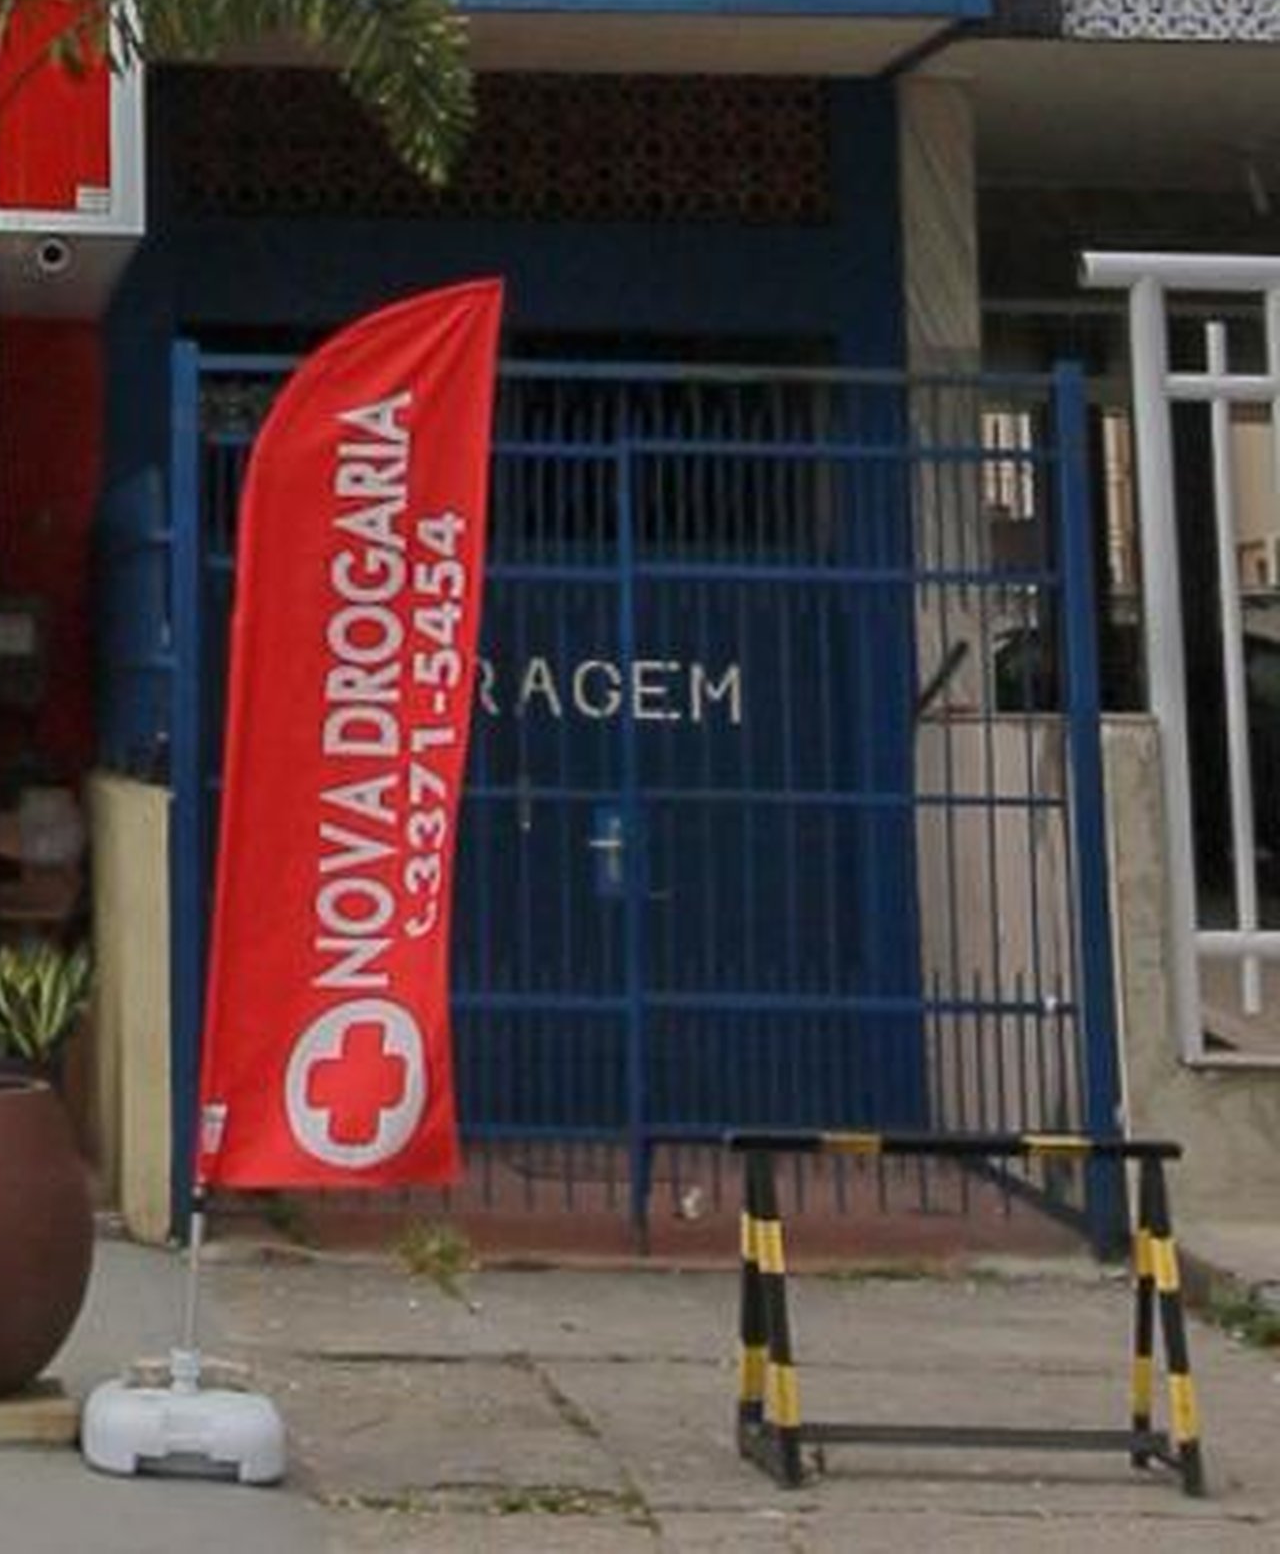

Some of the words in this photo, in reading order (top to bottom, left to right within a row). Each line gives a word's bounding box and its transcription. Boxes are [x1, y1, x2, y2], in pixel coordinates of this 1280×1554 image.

[323, 390, 412, 756] DROGARIA
[404, 511, 465, 898] 3371-5454
[313, 773, 399, 989] NOVA
